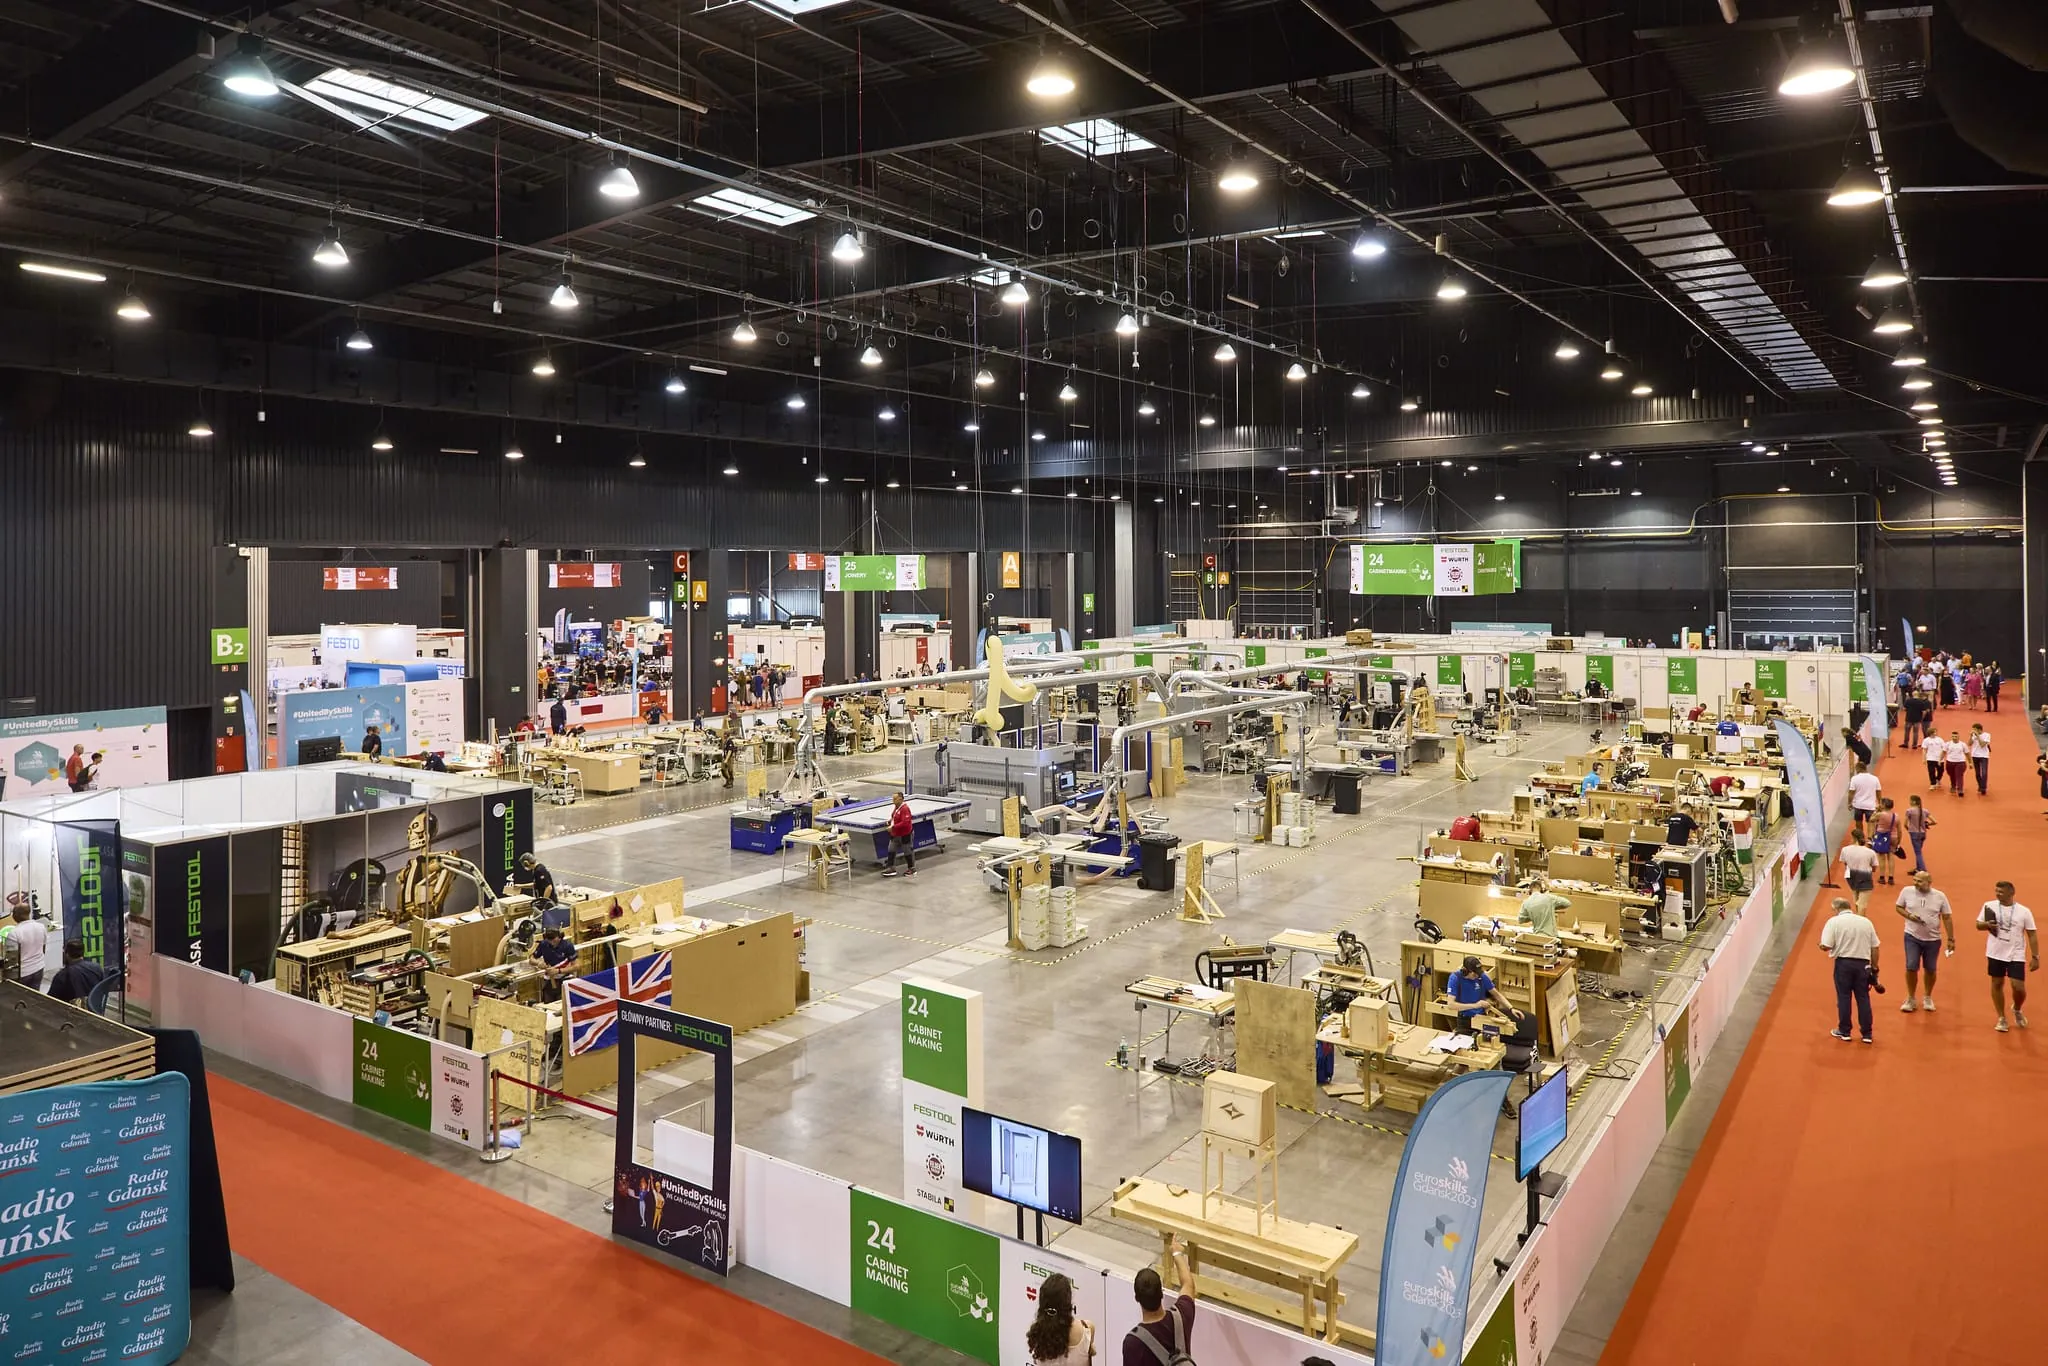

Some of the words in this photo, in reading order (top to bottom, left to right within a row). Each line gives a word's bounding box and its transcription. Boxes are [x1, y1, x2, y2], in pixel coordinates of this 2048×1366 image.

[676, 556, 685, 569] C
[844, 561, 857, 571] 25
[1004, 554, 1018, 573] A
[1206, 556, 1213, 565] C
[1369, 553, 1384, 566] 24
[1207, 573, 1213, 582] B
[1220, 573, 1227, 582] A
[677, 585, 685, 598] B
[695, 585, 704, 598] A
[216, 634, 244, 657] B2
[327, 636, 360, 650] FESTO
[3, 716, 79, 730] #UnitedBySkills
[505, 799, 514, 871] FESTOOL
[124, 851, 150, 865] FESTOOL
[187, 850, 201, 938] FESTOOL
[908, 994, 929, 1018] 24
[621, 1009, 645, 1026] GŁÓWNY
[645, 1015, 672, 1033] PARTNER:
[674, 1023, 728, 1048] FESTOOL
[908, 1022, 943, 1041] CABINET
[361, 1038, 379, 1061] 24
[908, 1033, 943, 1053] MAKING
[361, 1062, 385, 1078] CABINET
[442, 1055, 471, 1071] FESTOOL
[361, 1071, 385, 1088] MAKING
[51, 1100, 81, 1112] Radio
[913, 1103, 957, 1126] FESTOOL
[36, 1108, 81, 1124] Gdańsk
[134, 1112, 166, 1126] Radio
[70, 1132, 91, 1141] Radio
[118, 1121, 166, 1139] Gdańsk
[0, 1149, 40, 1170] ańsk
[96, 1154, 120, 1164] Radio
[85, 1162, 120, 1174] Gdańsk
[128, 1168, 169, 1185] Radio
[107, 1179, 168, 1203] Gdańsk
[1414, 1171, 1468, 1194] euroskills
[661, 1178, 727, 1212] #UnitedBySkills
[916, 1188, 942, 1205] STABILA
[0, 1187, 75, 1224] adio
[140, 1206, 168, 1219] Radio
[666, 1192, 674, 1200] WE
[674, 1194, 683, 1204] CAN
[683, 1197, 701, 1210] CHANGE
[701, 1205, 710, 1214] THE
[710, 1208, 727, 1220] WORLD
[127, 1214, 168, 1232] Gdańsk
[867, 1220, 896, 1255] 24
[44, 1267, 74, 1280] Radio
[866, 1254, 909, 1280] CABINET
[29, 1275, 73, 1294] Gdańsk
[137, 1275, 166, 1288] Radio
[866, 1267, 909, 1294] MAKING
[123, 1282, 166, 1301] Gdańsk
[1403, 1280, 1456, 1305] euroskills
[75, 1321, 106, 1334] Radio
[136, 1328, 165, 1341] Radio
[61, 1329, 105, 1348] Gdańsk
[122, 1336, 165, 1355] Gdańsk
